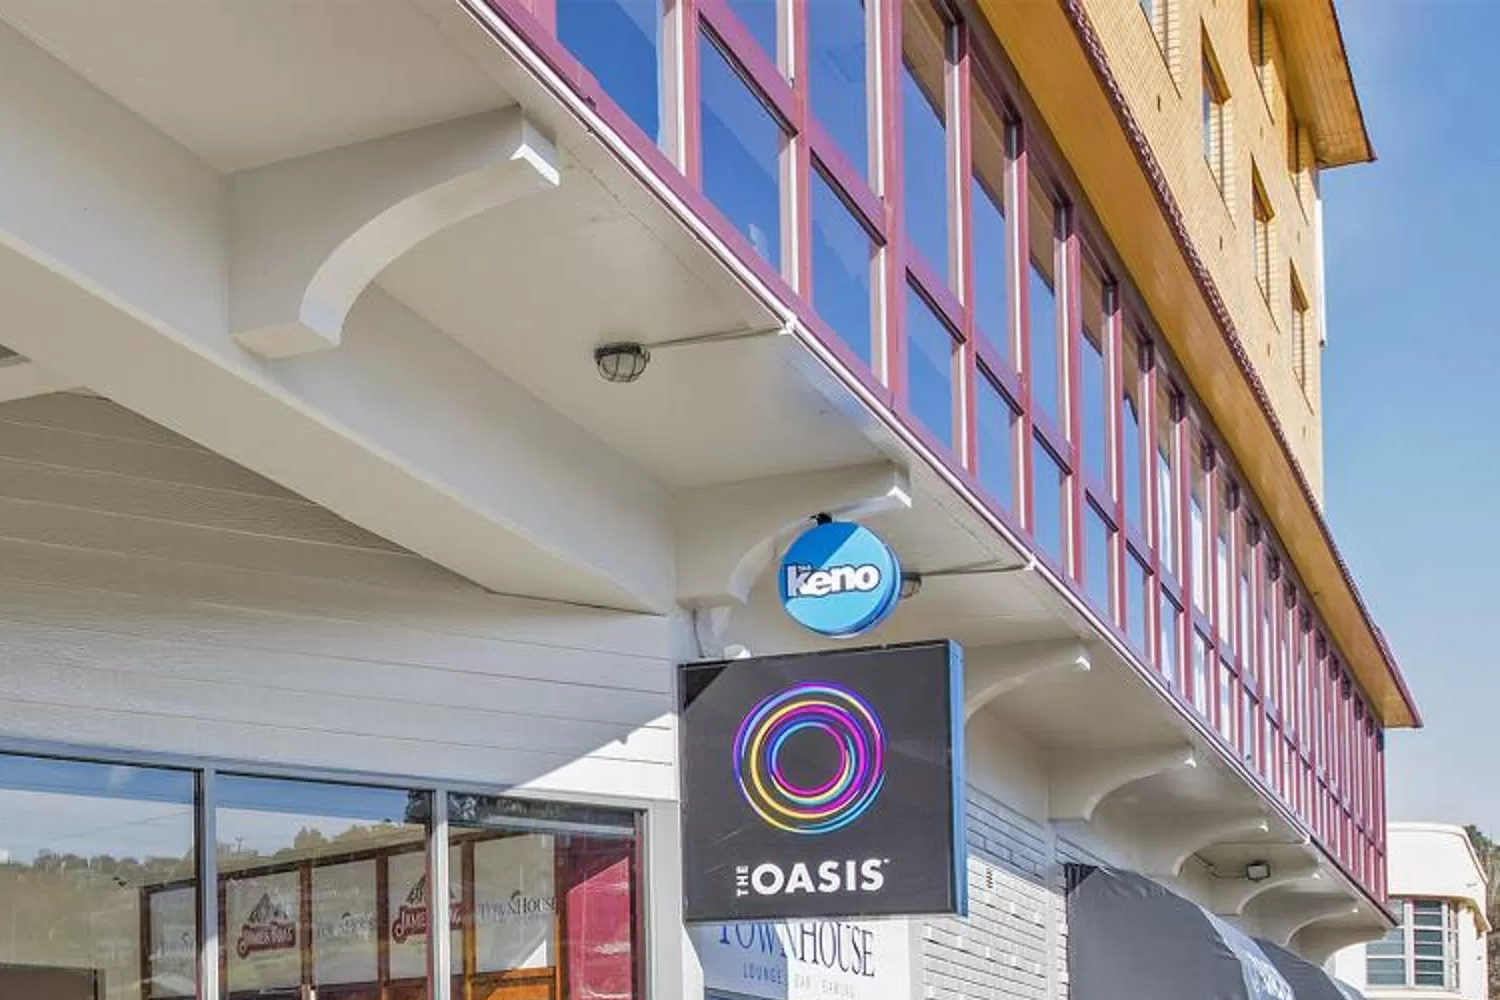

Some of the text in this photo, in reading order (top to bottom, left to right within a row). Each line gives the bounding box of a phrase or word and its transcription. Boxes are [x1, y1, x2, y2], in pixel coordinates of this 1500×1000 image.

[785, 563, 881, 598] keno
[735, 858, 885, 897] THE OASIS
[743, 963, 782, 985] LOUNGE
